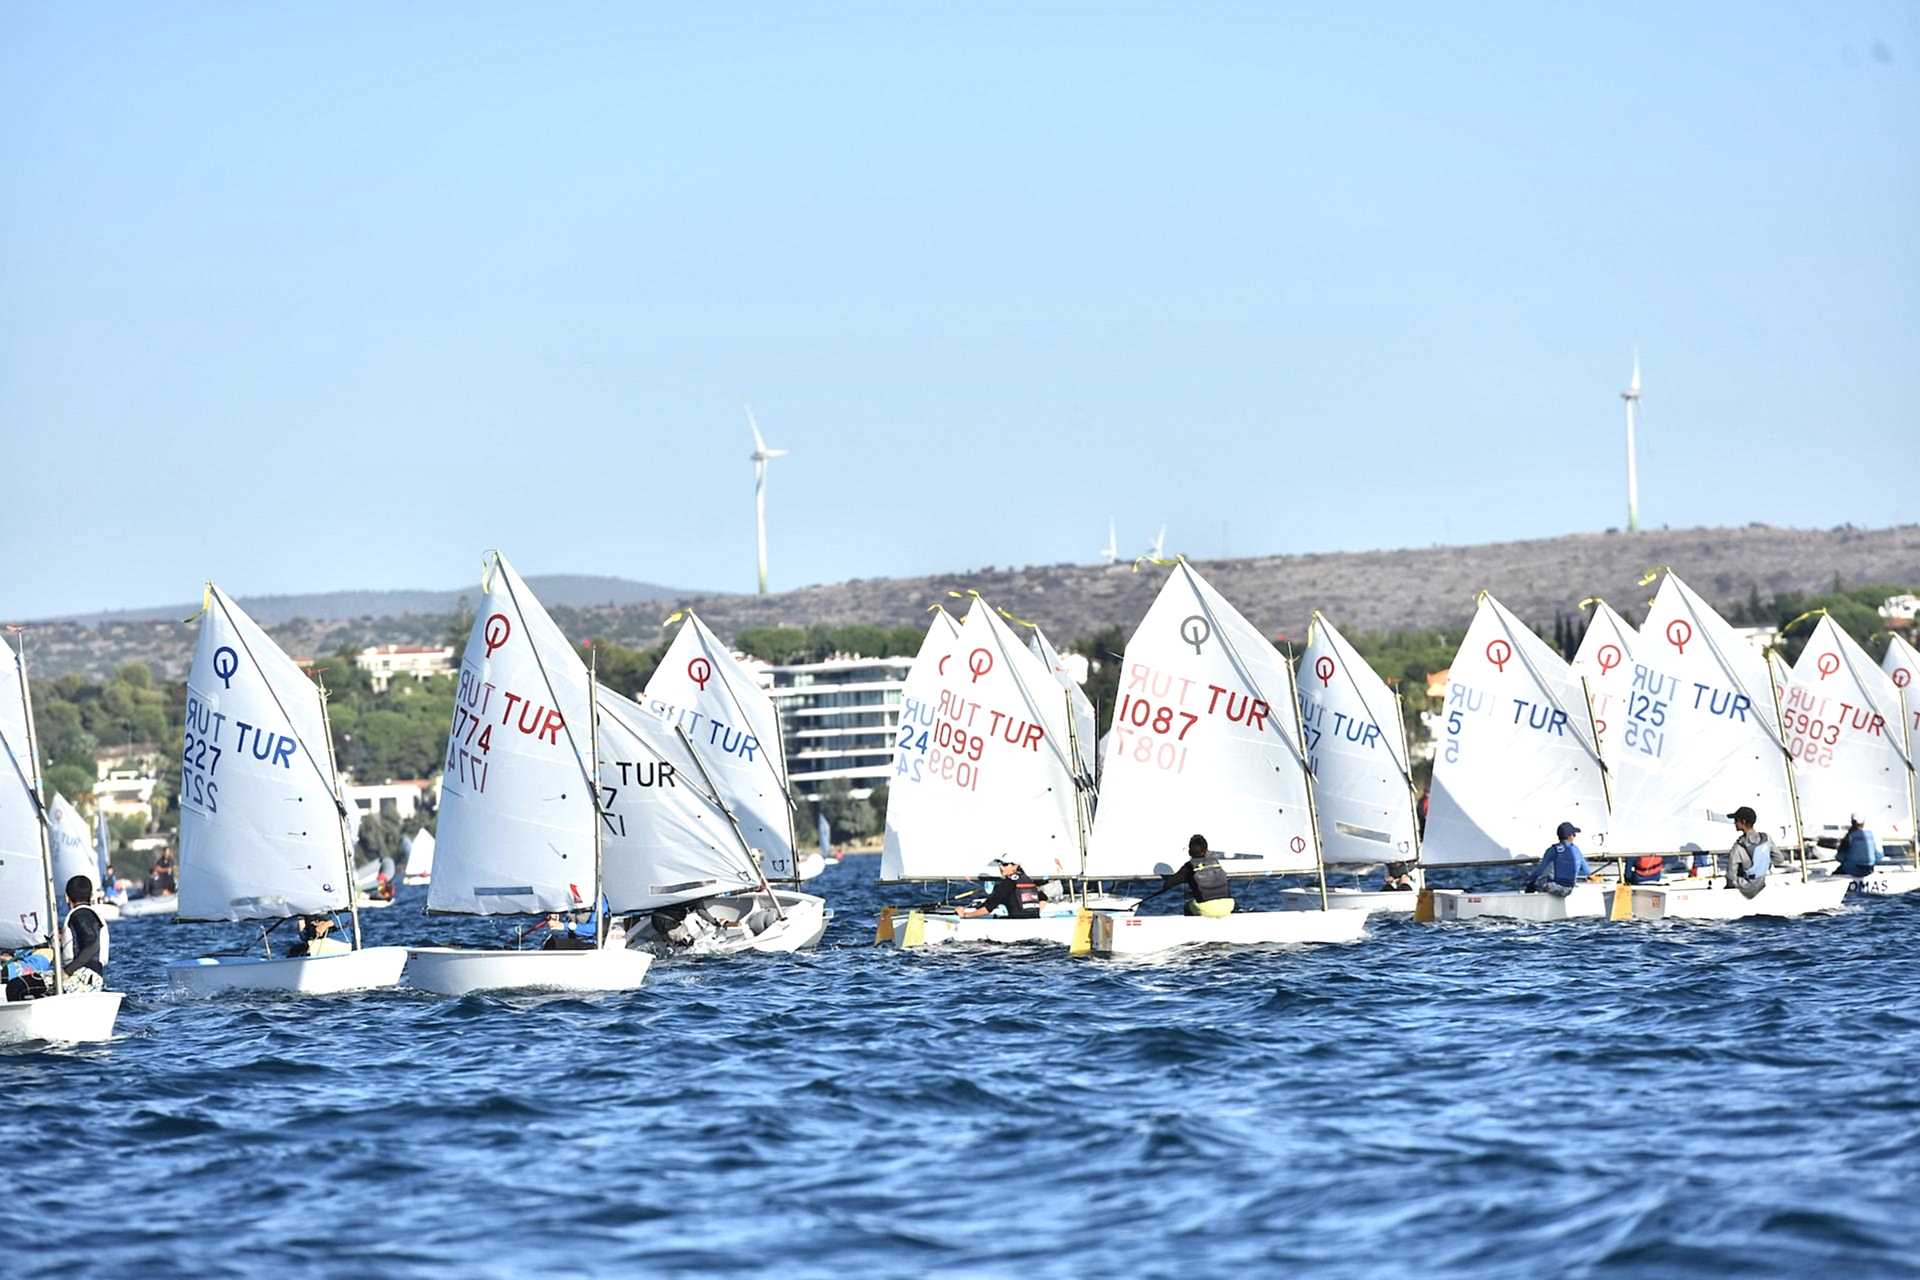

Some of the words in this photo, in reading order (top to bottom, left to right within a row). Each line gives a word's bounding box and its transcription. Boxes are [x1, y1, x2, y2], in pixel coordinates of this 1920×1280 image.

[504, 691, 567, 746] TUR
[1119, 694, 1198, 741] 1087
[1208, 684, 1270, 731] TUR
[1513, 698, 1568, 736] TUR
[1628, 690, 1668, 727] 125
[1694, 682, 1751, 723] TUR
[1840, 703, 1886, 737] TUR
[236, 721, 298, 769] TUR
[452, 704, 493, 756] 1774
[711, 719, 760, 762] TUR
[898, 724, 929, 755] 24
[933, 718, 984, 761] 1099
[990, 710, 1044, 752] TUR
[1334, 711, 1381, 749] TUR
[1783, 708, 1840, 745] 5903
[184, 732, 222, 776] 227
[616, 760, 677, 788] TUR
